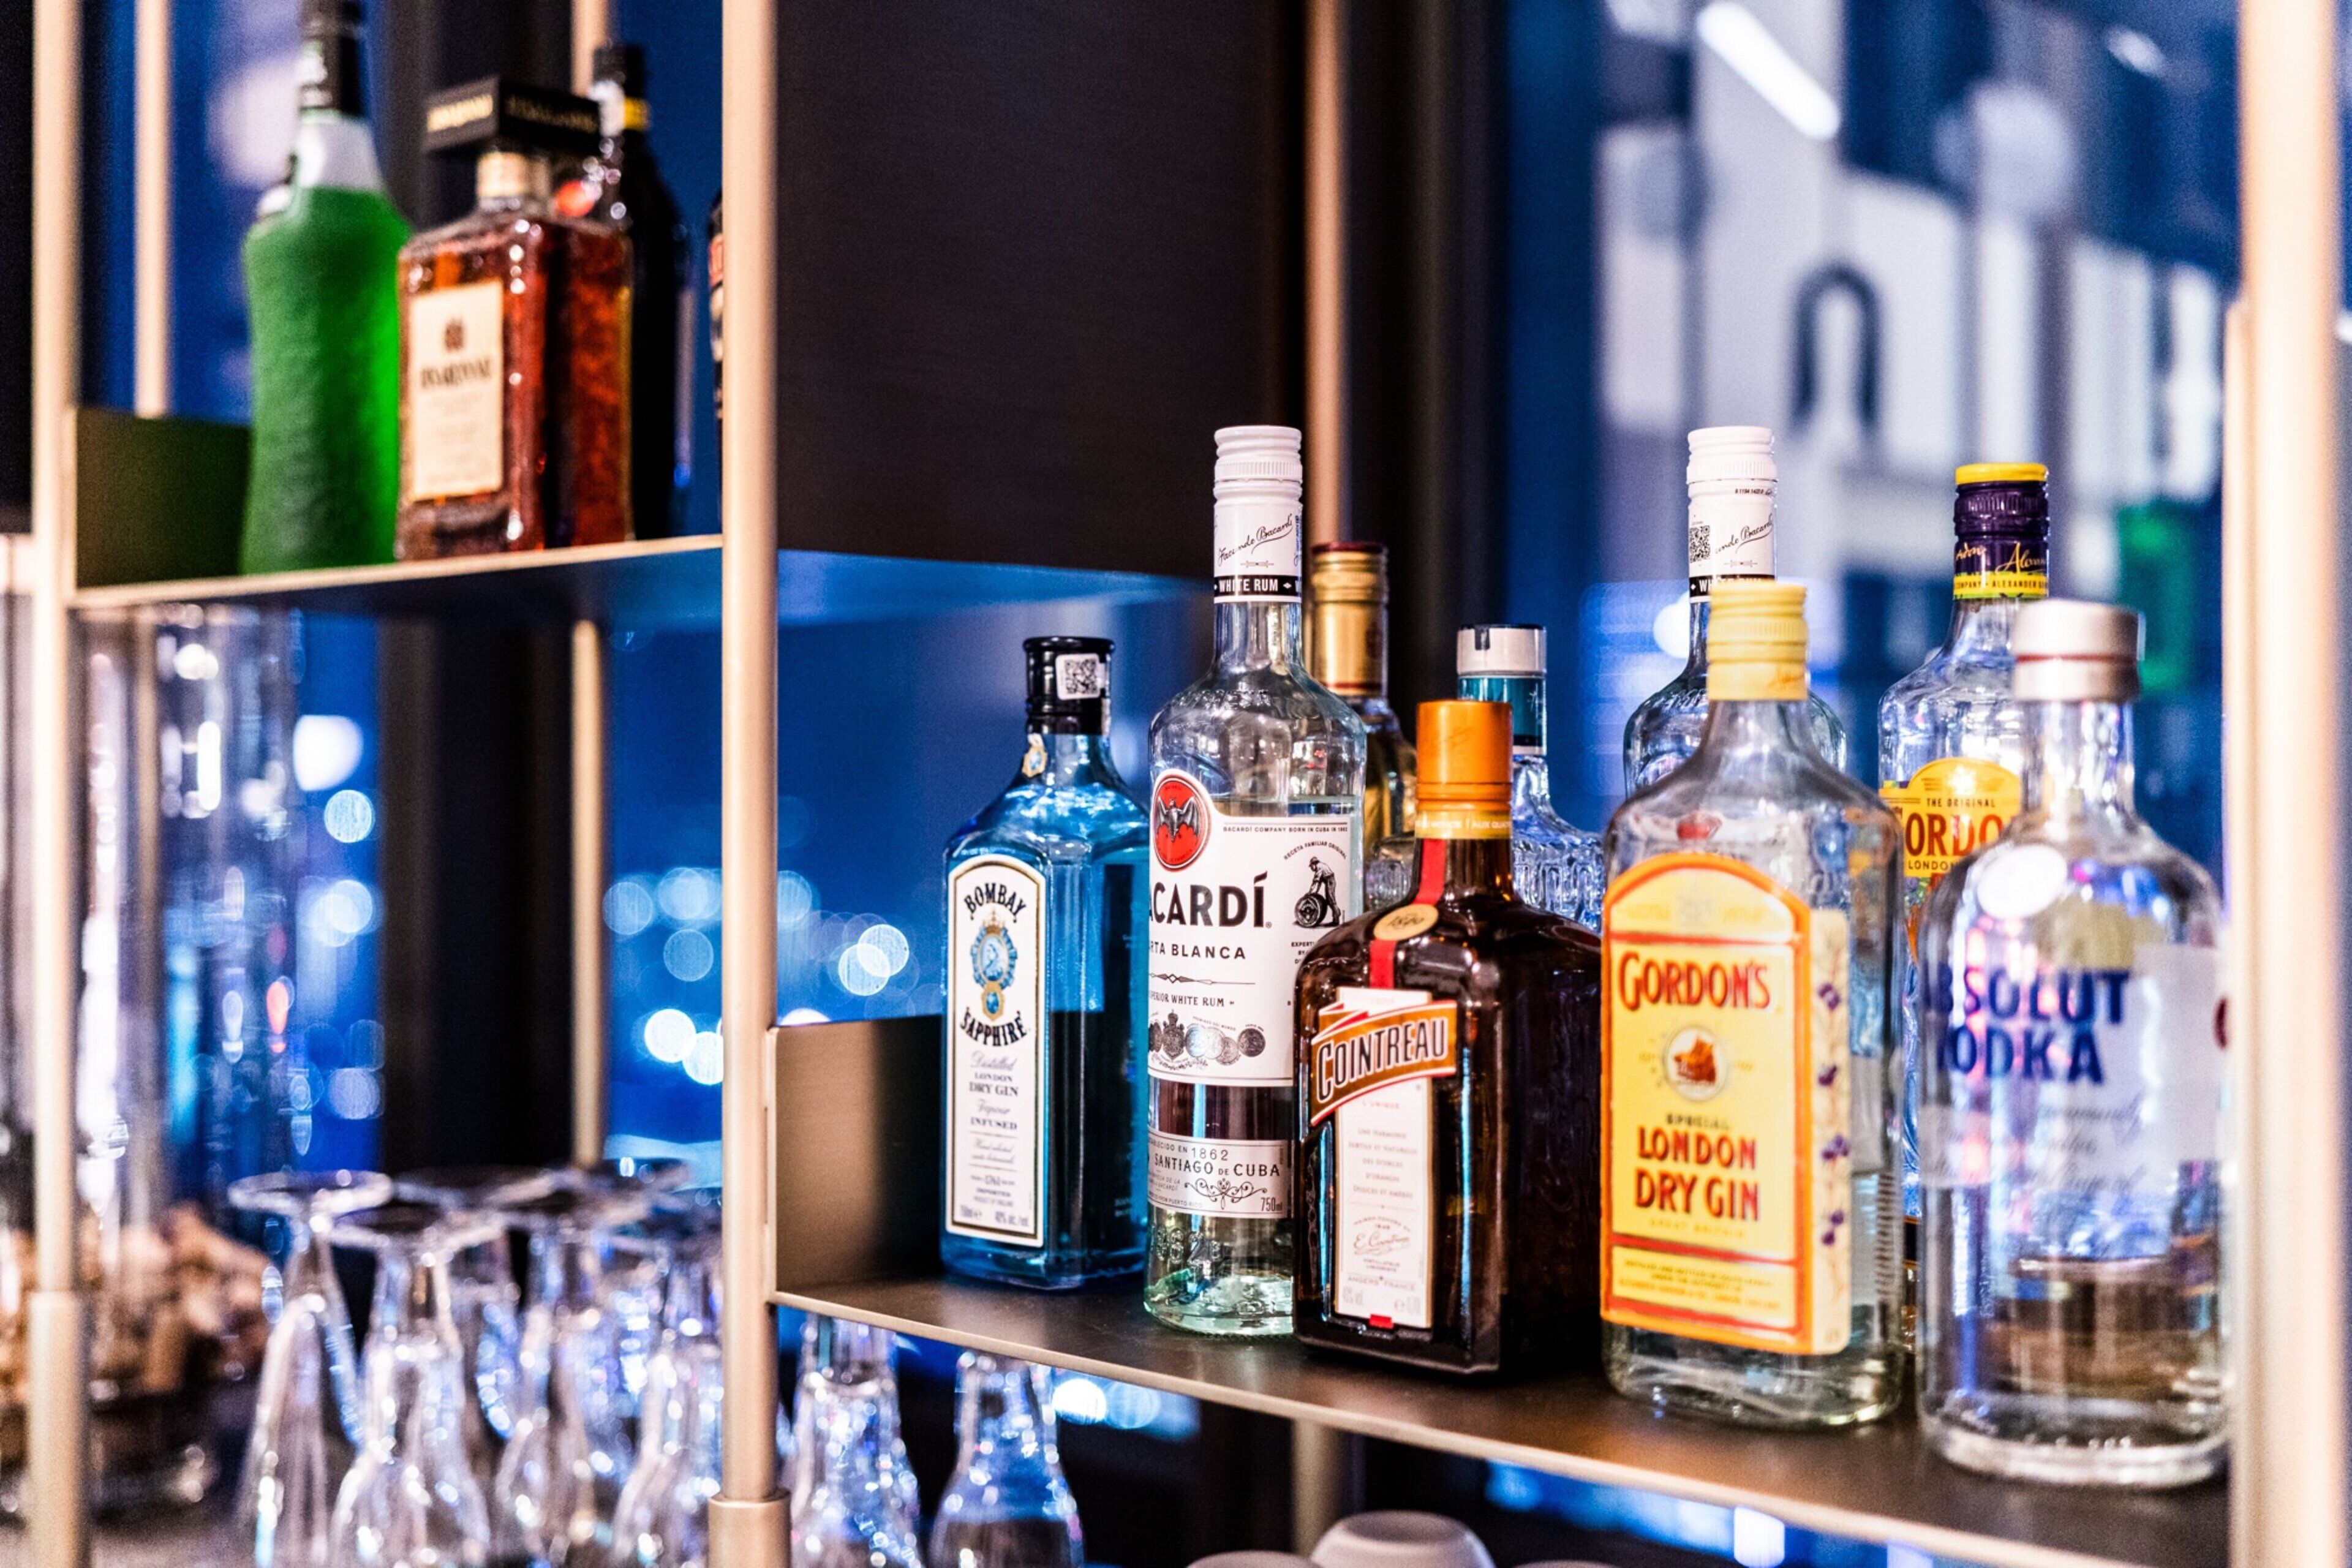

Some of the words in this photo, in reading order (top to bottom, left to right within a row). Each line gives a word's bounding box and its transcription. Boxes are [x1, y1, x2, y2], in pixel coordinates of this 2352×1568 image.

[1218, 579, 1250, 592] WHITE
[1253, 579, 1278, 592] RUM
[1955, 581, 1981, 589] OMPANY
[1992, 580, 2037, 589] ALEXANDER
[1927, 798, 1942, 807] THE
[1947, 798, 1996, 808] ORIGINAL
[1905, 812, 2003, 857] ORDO
[964, 883, 1026, 916] BOMBAY
[1149, 870, 1268, 929] CARDÍ
[1150, 941, 1166, 956] RTA
[1171, 943, 1246, 960] BLANCA
[1618, 951, 1770, 1011] GORDON'S
[1150, 990, 1169, 1003] PERIOR
[1171, 993, 1198, 1006] WHITE
[1202, 997, 1224, 1007] RUM
[960, 1014, 1028, 1047] SAPPHIRE
[1317, 1018, 1447, 1102] COINTREAU
[974, 1072, 1012, 1082] LONDON
[969, 1081, 992, 1094] DRY
[995, 1084, 1019, 1096] GIN
[970, 1117, 1017, 1130] INFUSED
[1666, 1113, 1731, 1131] SPECIAL
[1178, 1145, 1188, 1153] EN
[1191, 1147, 1229, 1161] 1862
[1637, 1125, 1757, 1170] LONDON
[1154, 1153, 1213, 1175] SANTIAGO
[1233, 1164, 1280, 1177] CUBA
[1635, 1167, 1697, 1215] DRY
[1703, 1176, 1758, 1222] GIN
[1261, 1197, 1283, 1212] 750ml
